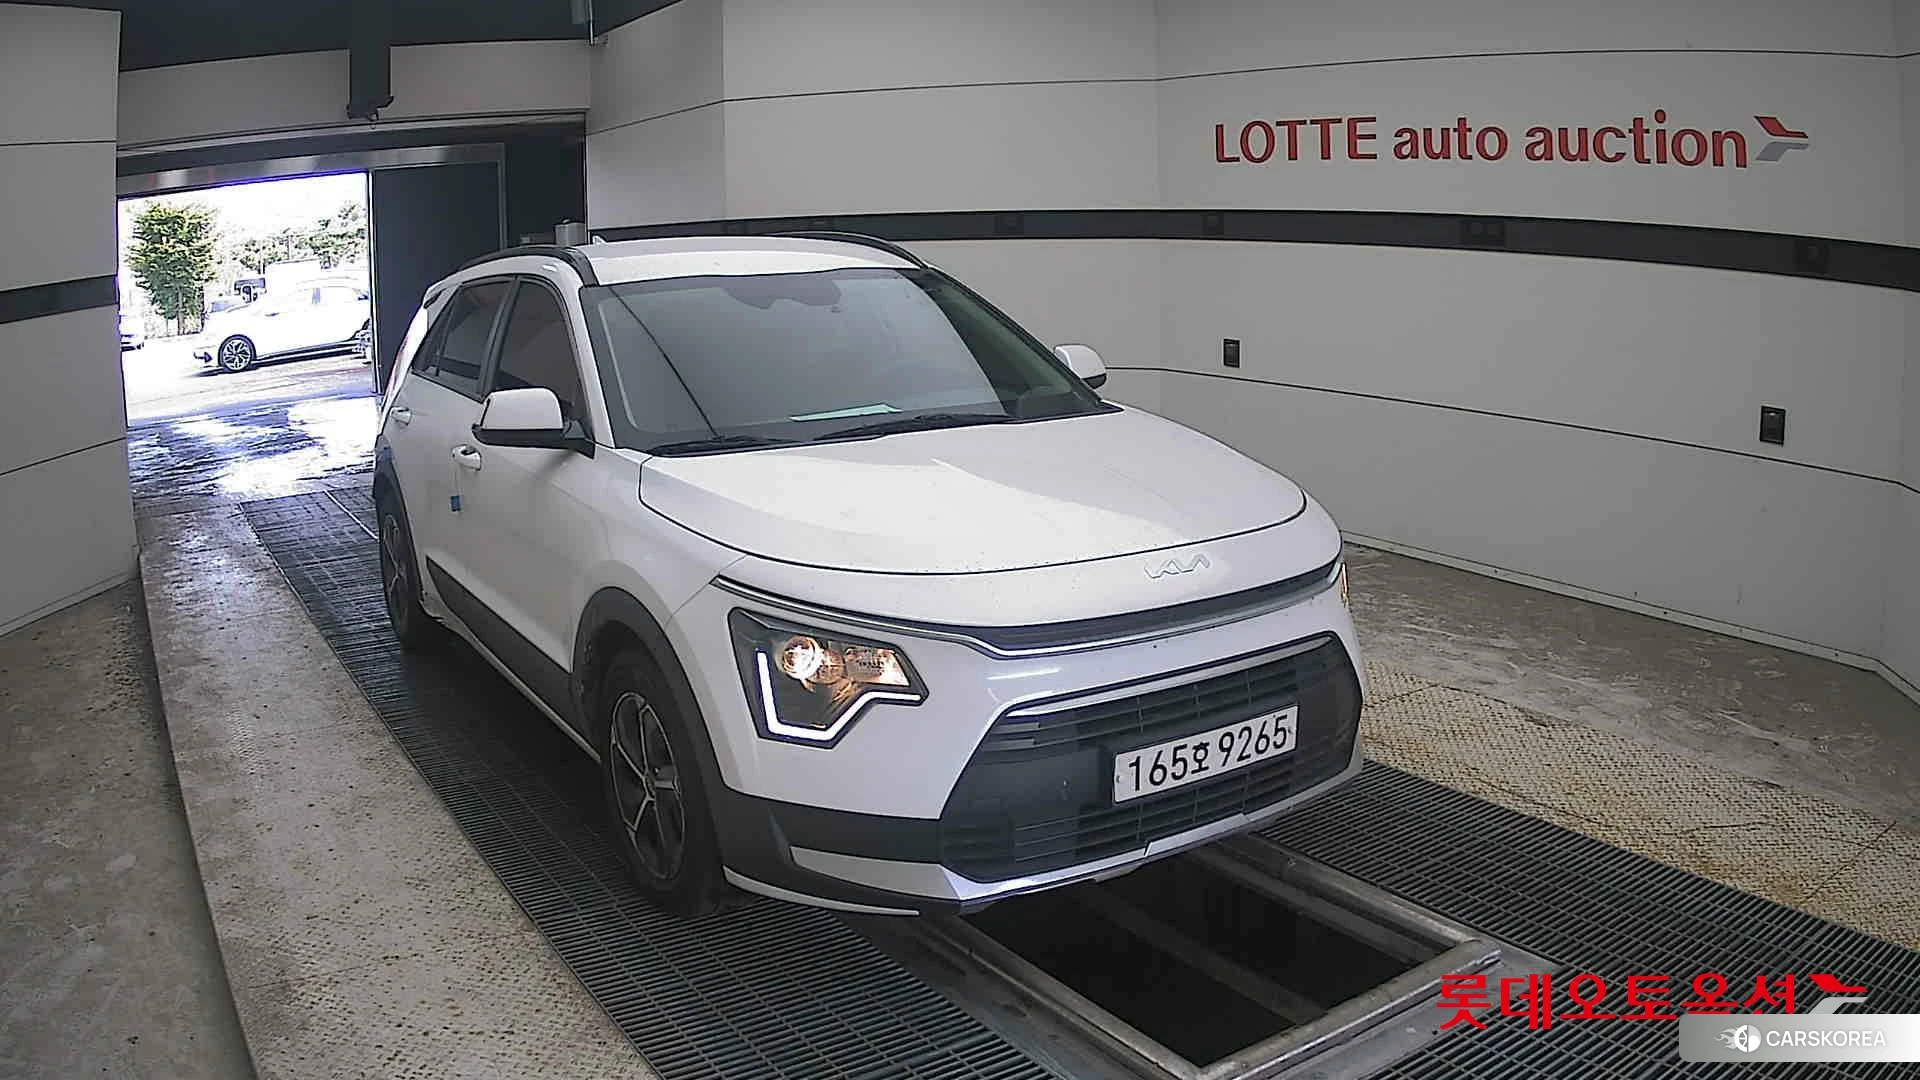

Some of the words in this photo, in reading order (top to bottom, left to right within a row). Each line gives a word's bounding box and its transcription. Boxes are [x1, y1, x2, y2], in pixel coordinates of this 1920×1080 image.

[1215, 116, 1378, 164] LOTTE
[1393, 117, 1509, 162] auto
[1525, 109, 1748, 169] auction
[1128, 742, 1210, 792] 165호
[1218, 714, 1288, 767] 9265
